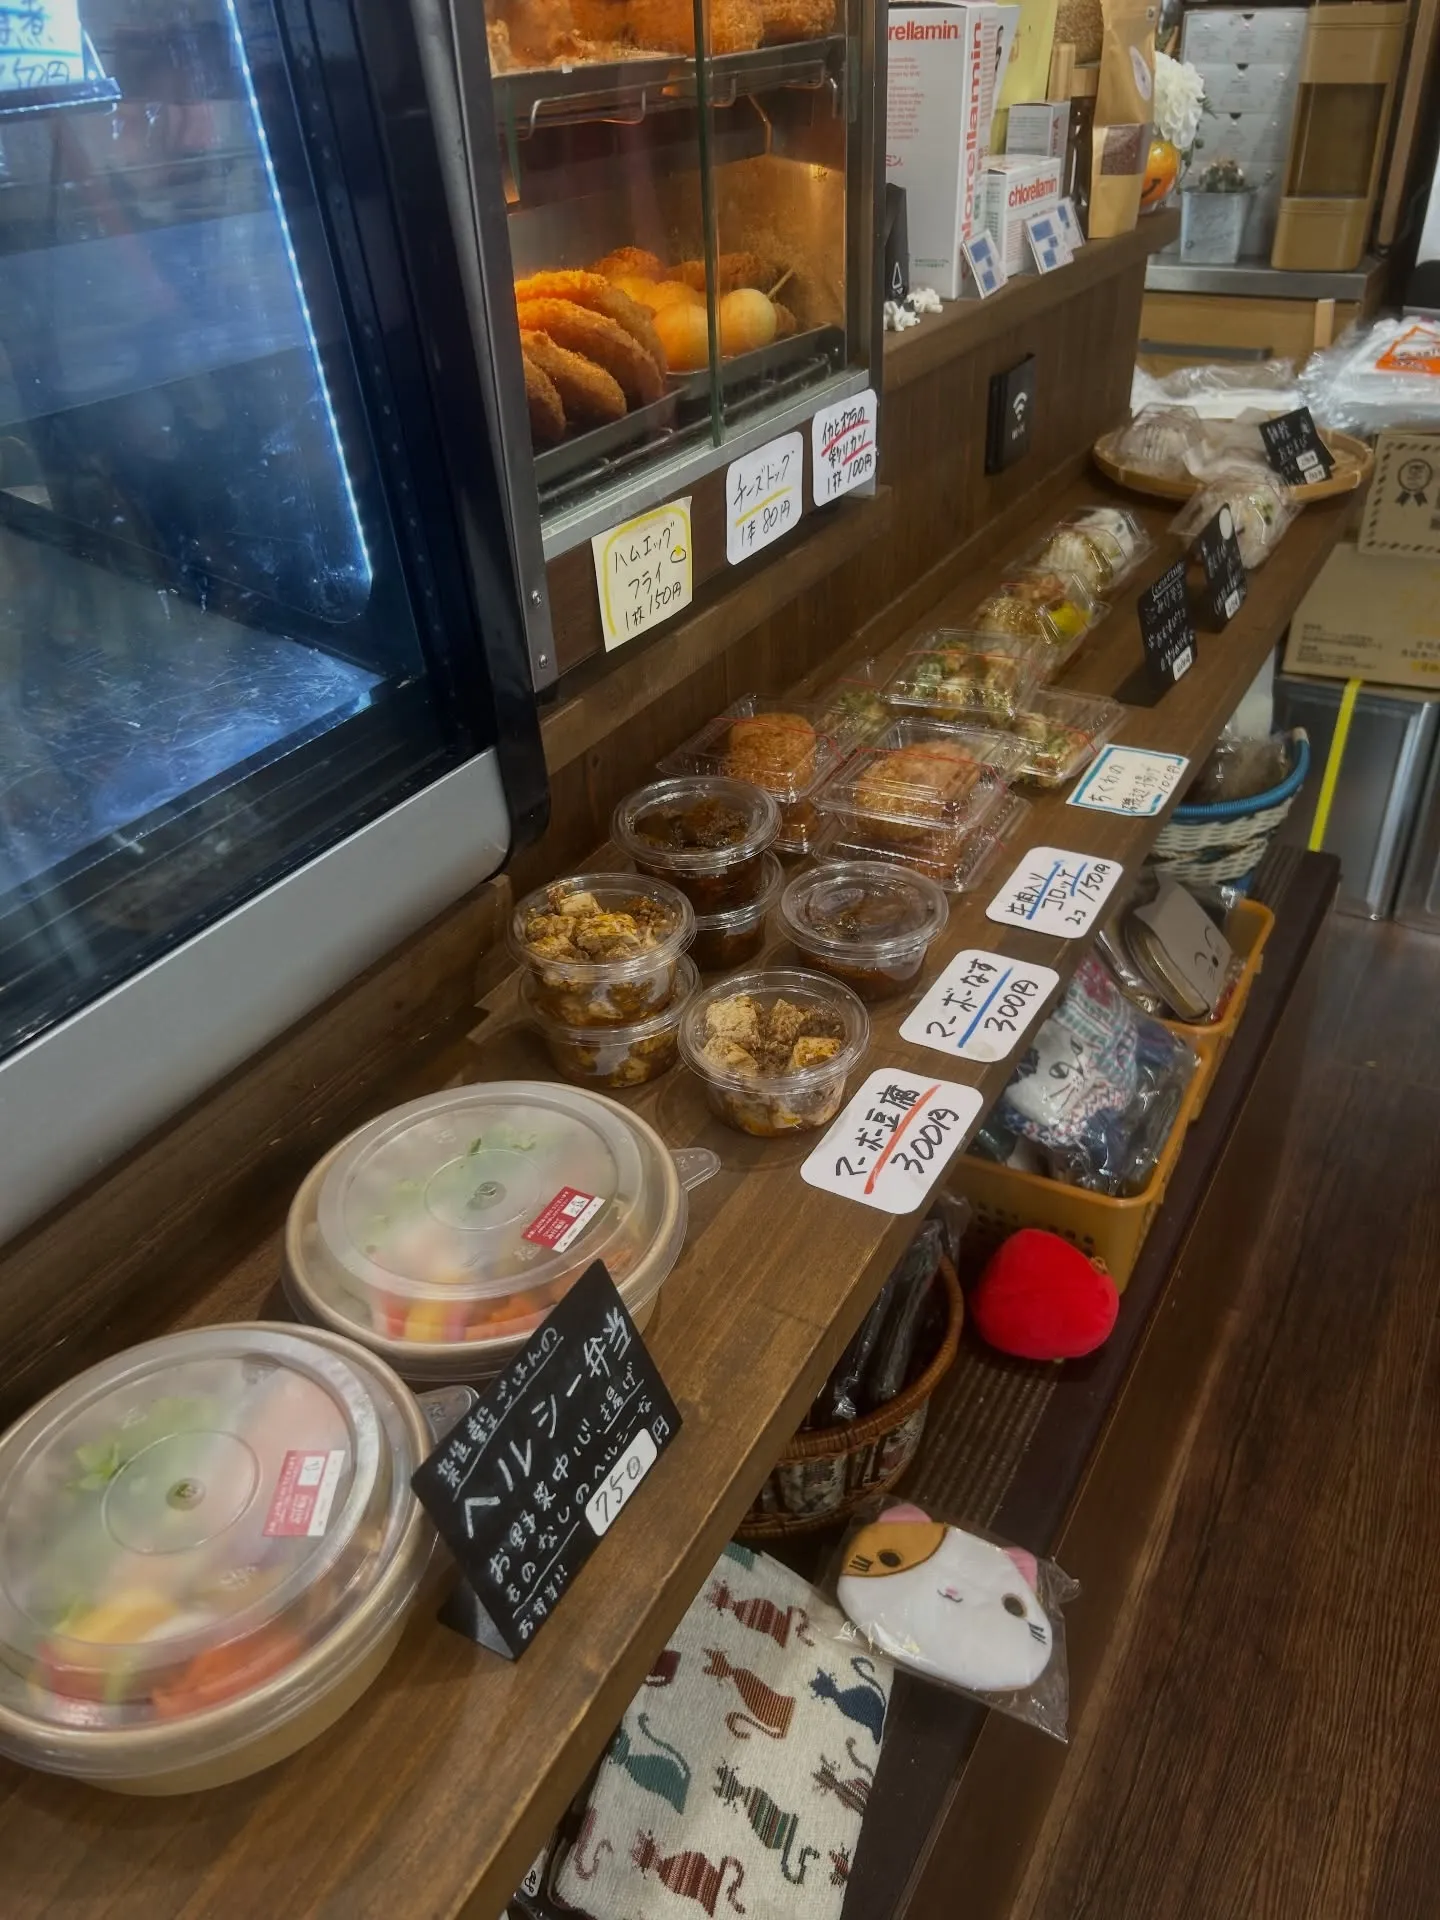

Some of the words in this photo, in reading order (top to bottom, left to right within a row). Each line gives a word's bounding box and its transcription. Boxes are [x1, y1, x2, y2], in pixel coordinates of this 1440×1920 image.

[1008, 175, 1058, 208] chlorellamin
[734, 450, 795, 513] チーズドッグ
[762, 500, 791, 535] 80円
[614, 521, 675, 574] ハムエッグ
[628, 561, 662, 600] フライ
[1088, 764, 1125, 802] ちくわの
[1040, 868, 1077, 911] コロッケ
[1076, 863, 1111, 903] 150円
[925, 958, 998, 1038] マーボーなす
[983, 979, 1039, 1033] 300円
[835, 1084, 921, 1177] マーボー豆腐
[890, 1108, 960, 1174] 300円
[464, 1306, 632, 1540] ヘルシー弁当
